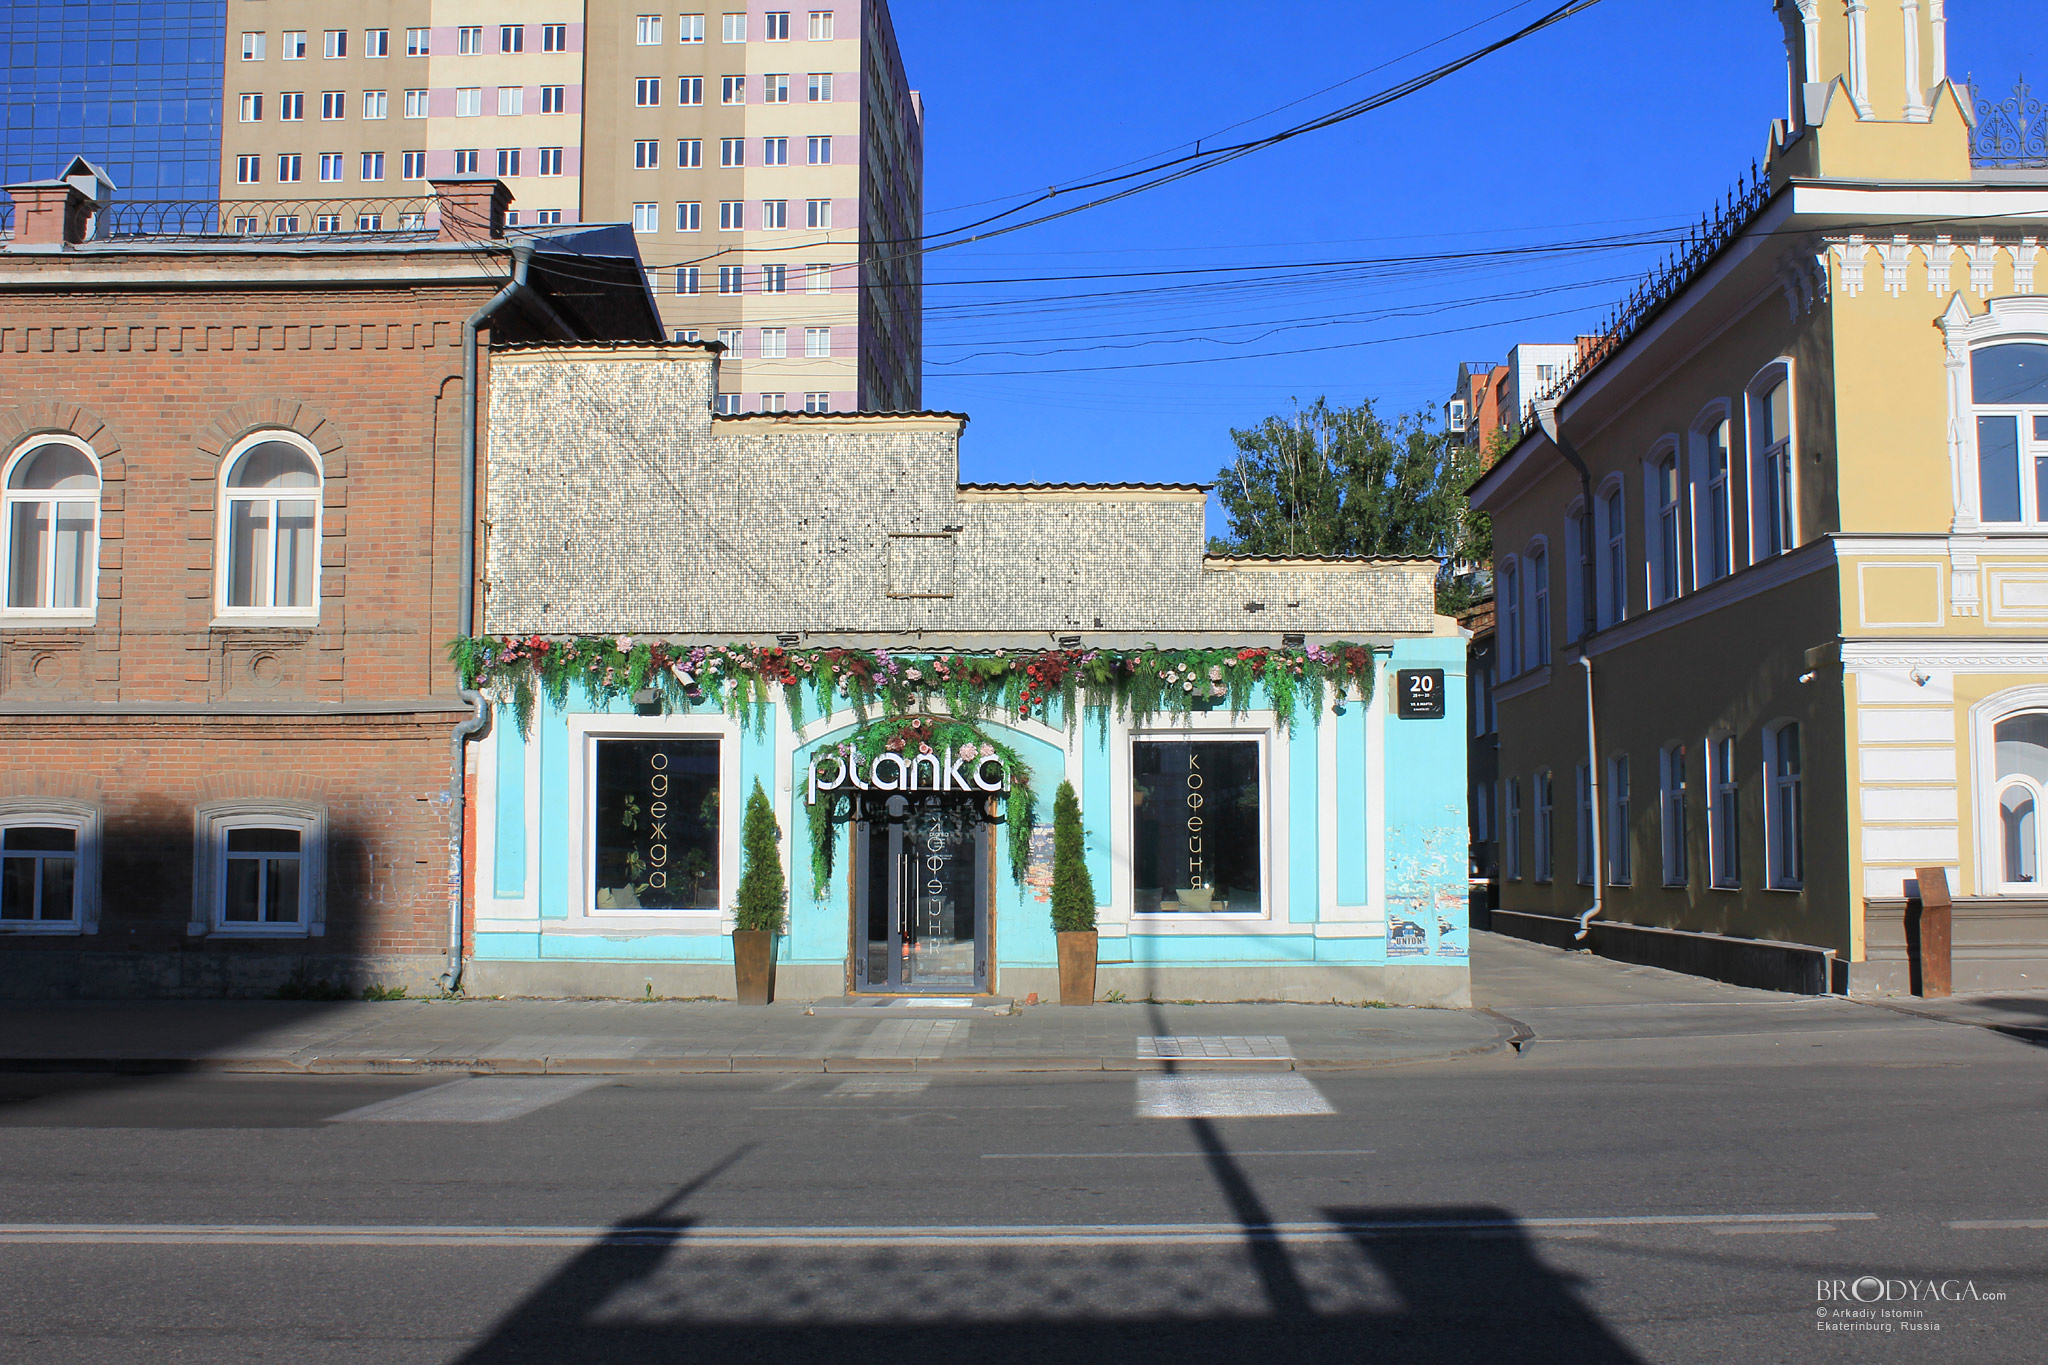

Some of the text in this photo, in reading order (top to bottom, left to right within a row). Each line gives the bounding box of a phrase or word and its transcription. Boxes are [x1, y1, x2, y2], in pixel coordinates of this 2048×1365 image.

[1409, 675, 1433, 692] 20
[808, 743, 1011, 804] planka
[1396, 937, 1422, 945] UNION
